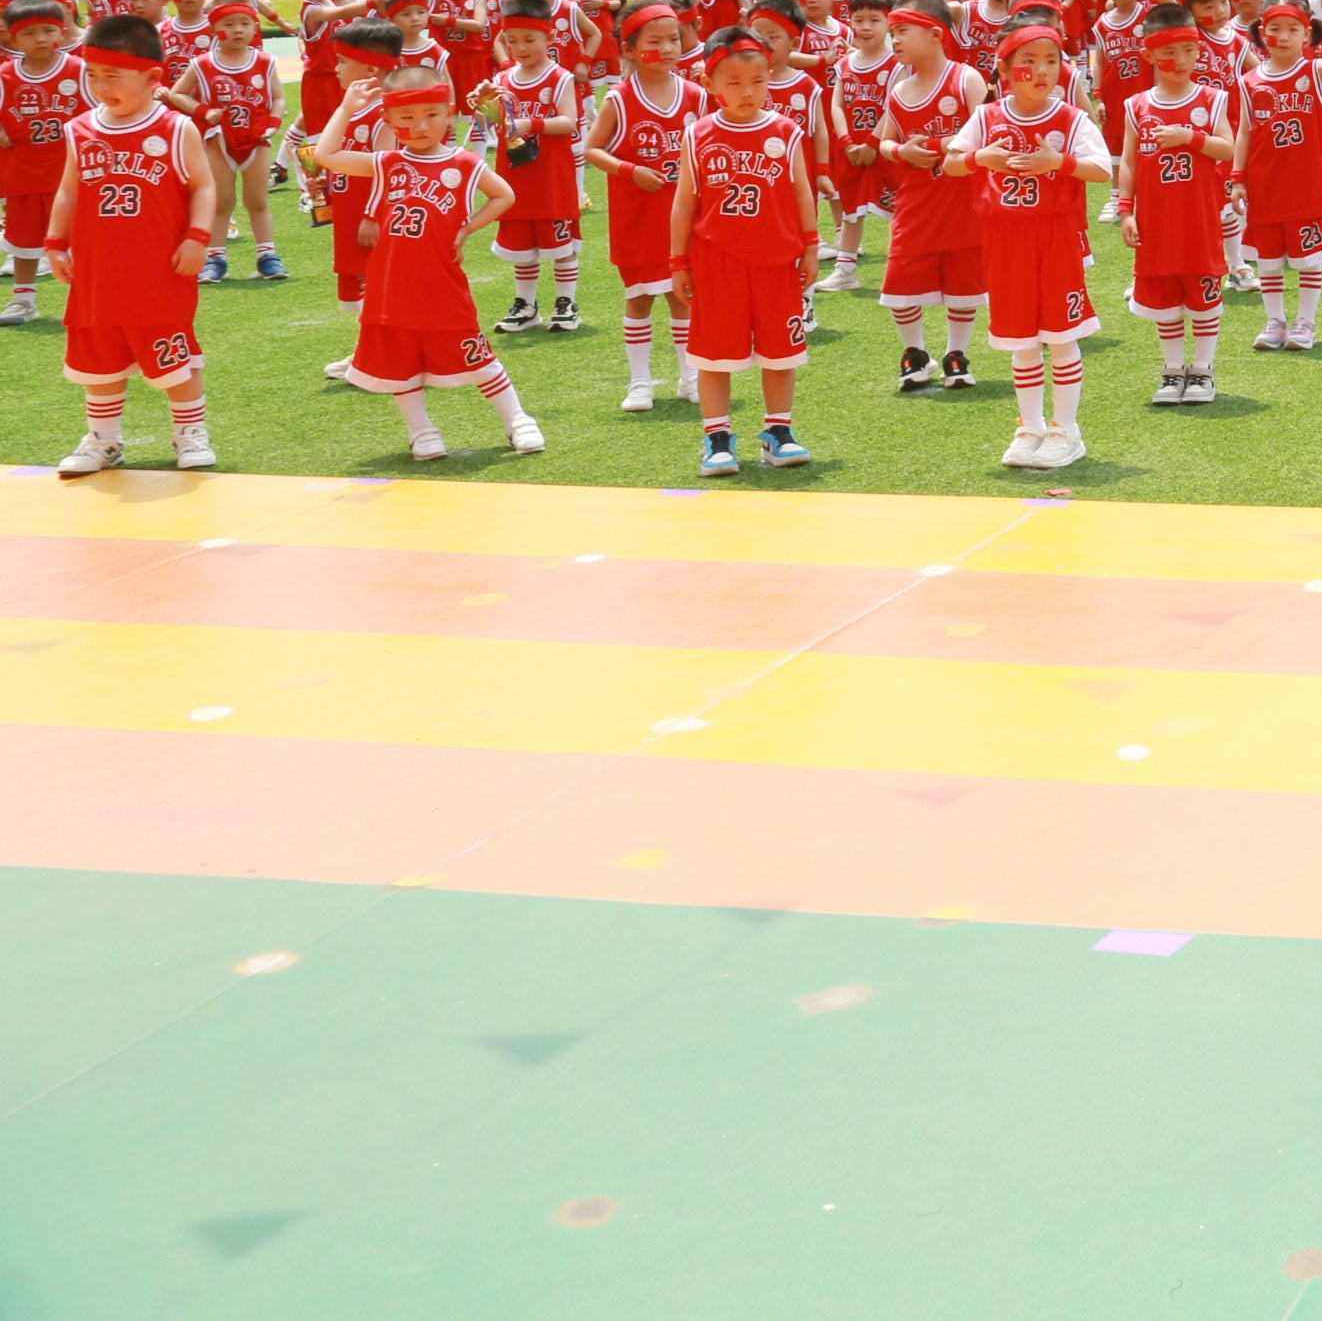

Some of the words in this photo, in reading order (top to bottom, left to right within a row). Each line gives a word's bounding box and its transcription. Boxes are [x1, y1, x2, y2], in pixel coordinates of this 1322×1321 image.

[1106, 37, 1121, 51] 103
[826, 66, 837, 88] 2
[1118, 57, 1140, 79] 23
[20, 93, 38, 105] 22
[215, 83, 231, 94] 23
[233, 84, 263, 106] KLR
[1278, 93, 1314, 114] KLR
[229, 106, 250, 129] 23
[852, 107, 877, 131] 23
[30, 118, 64, 144] 23
[638, 132, 658, 146] 94
[1271, 118, 1304, 148] 23
[80, 150, 105, 168] 116
[111, 151, 168, 185] KLR
[662, 159, 680, 183] 2
[707, 156, 727, 171] 40
[736, 151, 783, 186] KLR
[1159, 152, 1193, 183] 23
[390, 174, 407, 189] 99
[1000, 176, 1039, 207] 23
[98, 184, 141, 217] 23
[411, 175, 457, 215] KLR
[720, 183, 761, 217] 23
[389, 204, 427, 238] 23
[787, 315, 805, 346] 2
[153, 332, 191, 369] 23
